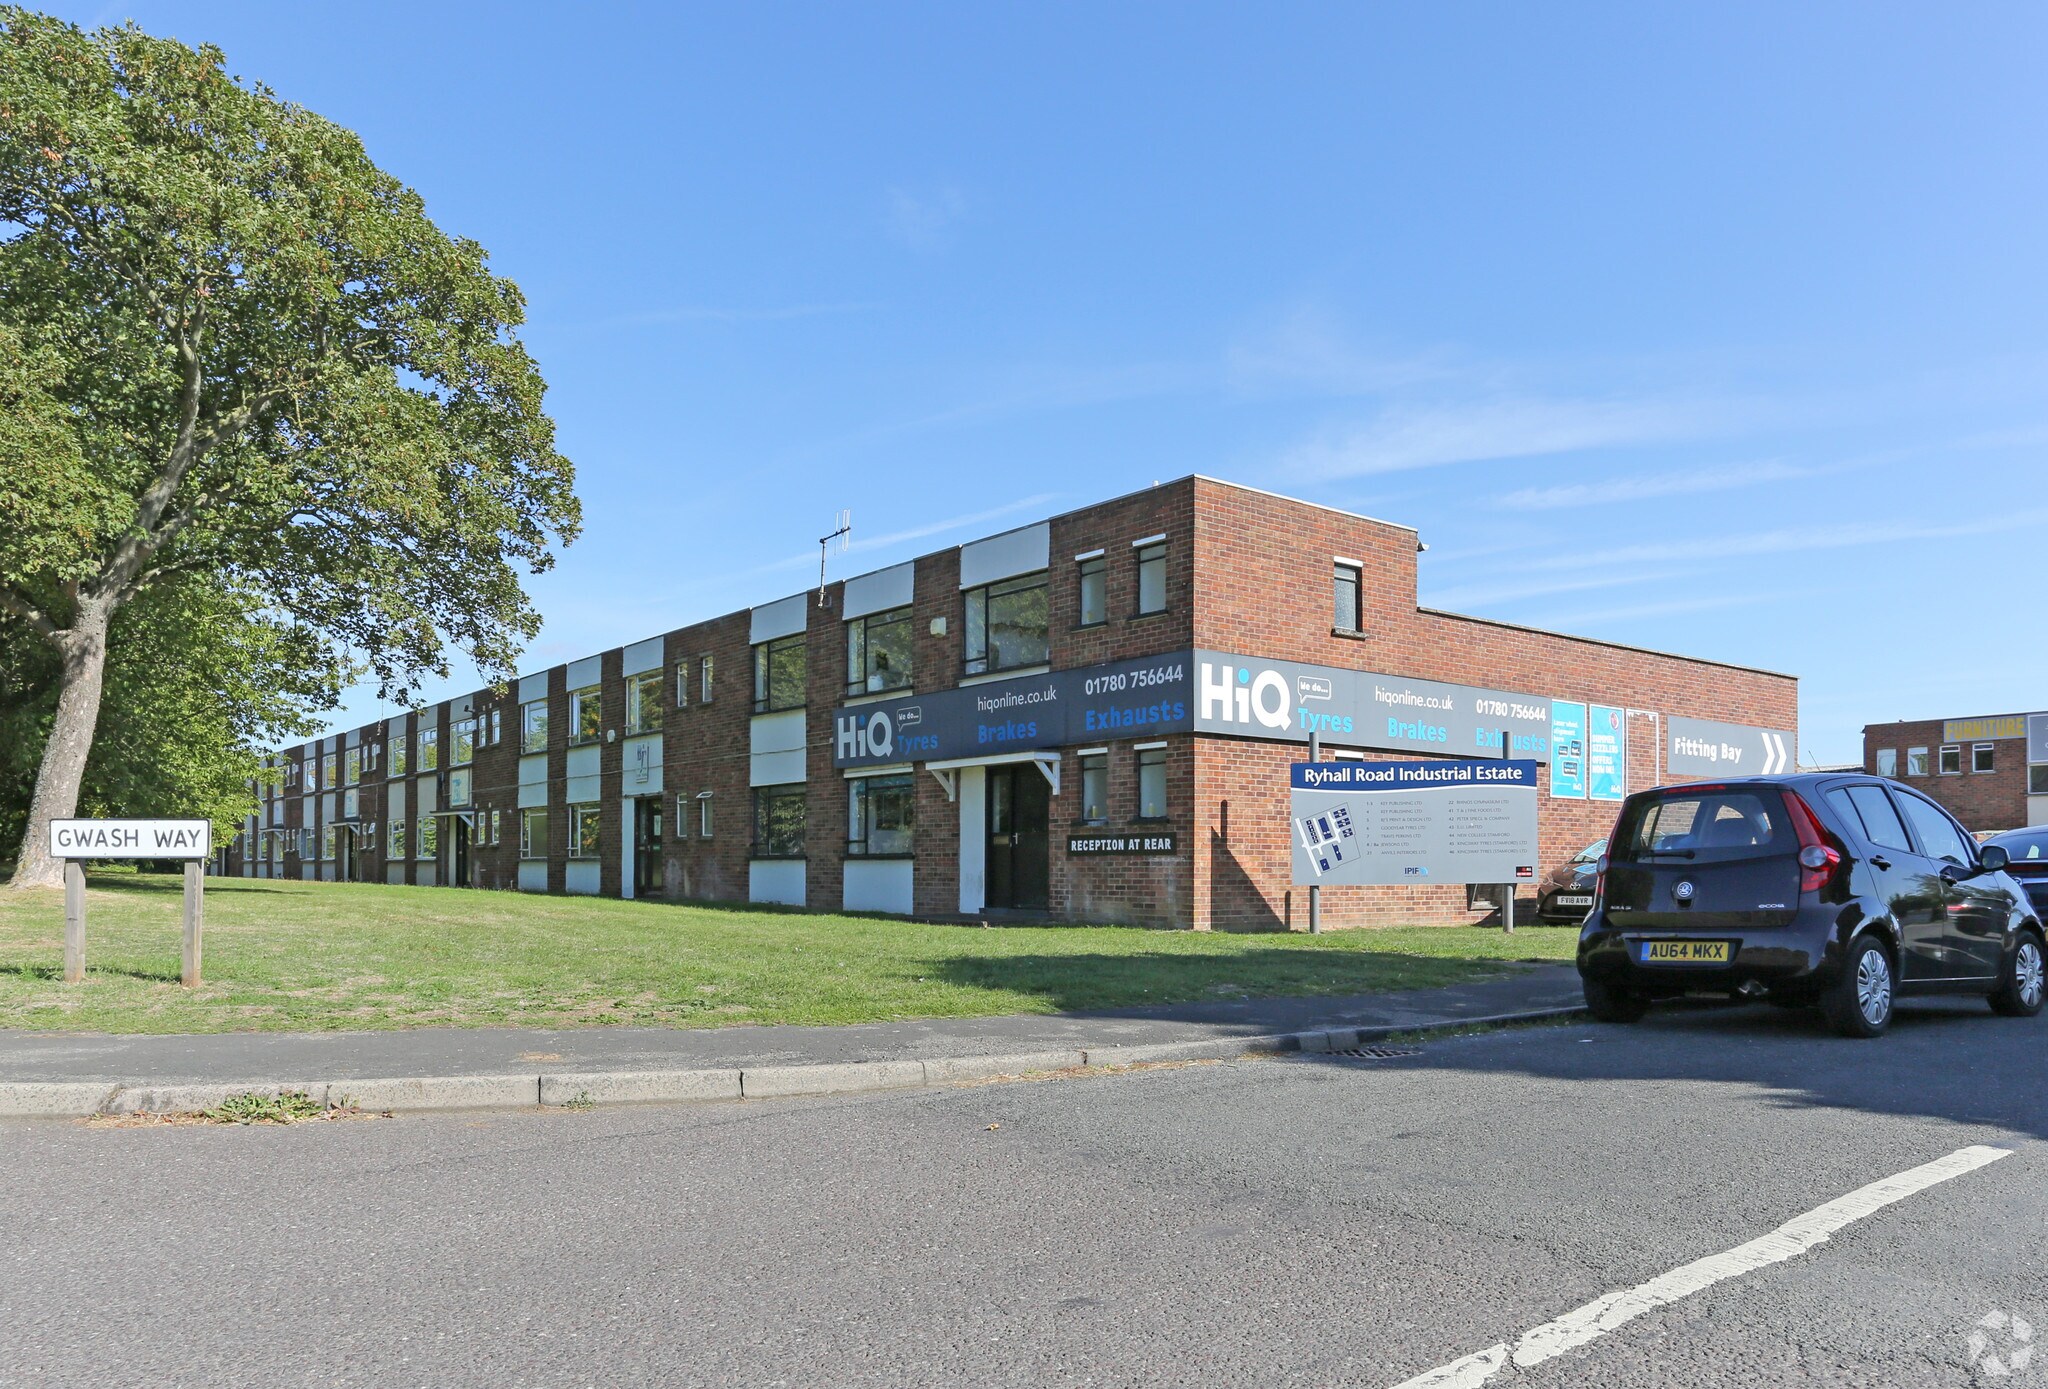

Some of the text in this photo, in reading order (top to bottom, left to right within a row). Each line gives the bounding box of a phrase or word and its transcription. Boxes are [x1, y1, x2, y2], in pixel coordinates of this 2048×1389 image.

[1085, 664, 1183, 696] 01780 756644
[1300, 681, 1310, 691] We
[977, 684, 1057, 713] hiqonline.co.uk
[1201, 662, 1292, 732] HiQ
[1375, 685, 1453, 711] hiqonline.co.uk
[1086, 699, 1185, 731] Exhausts
[1297, 707, 1353, 733] Tyres
[1476, 699, 1547, 722] 01780 756644
[837, 711, 893, 760] HiQ
[978, 719, 1037, 744] Brakes
[1387, 717, 1447, 743] Brakes
[1476, 727, 1546, 753] Exhusts
[1945, 717, 2025, 740] FURNITURE
[897, 734, 939, 756] Tyres
[1674, 736, 1742, 764] Fitting Bay
[1304, 766, 1522, 787] Ryhall Road Industrial Estate
[58, 828, 201, 848] GWASH WAY
[1071, 838, 1171, 851] RECEPTION AT REAR
[1404, 867, 1419, 875] IPIF
[1650, 944, 1724, 958] AU64 MKX
